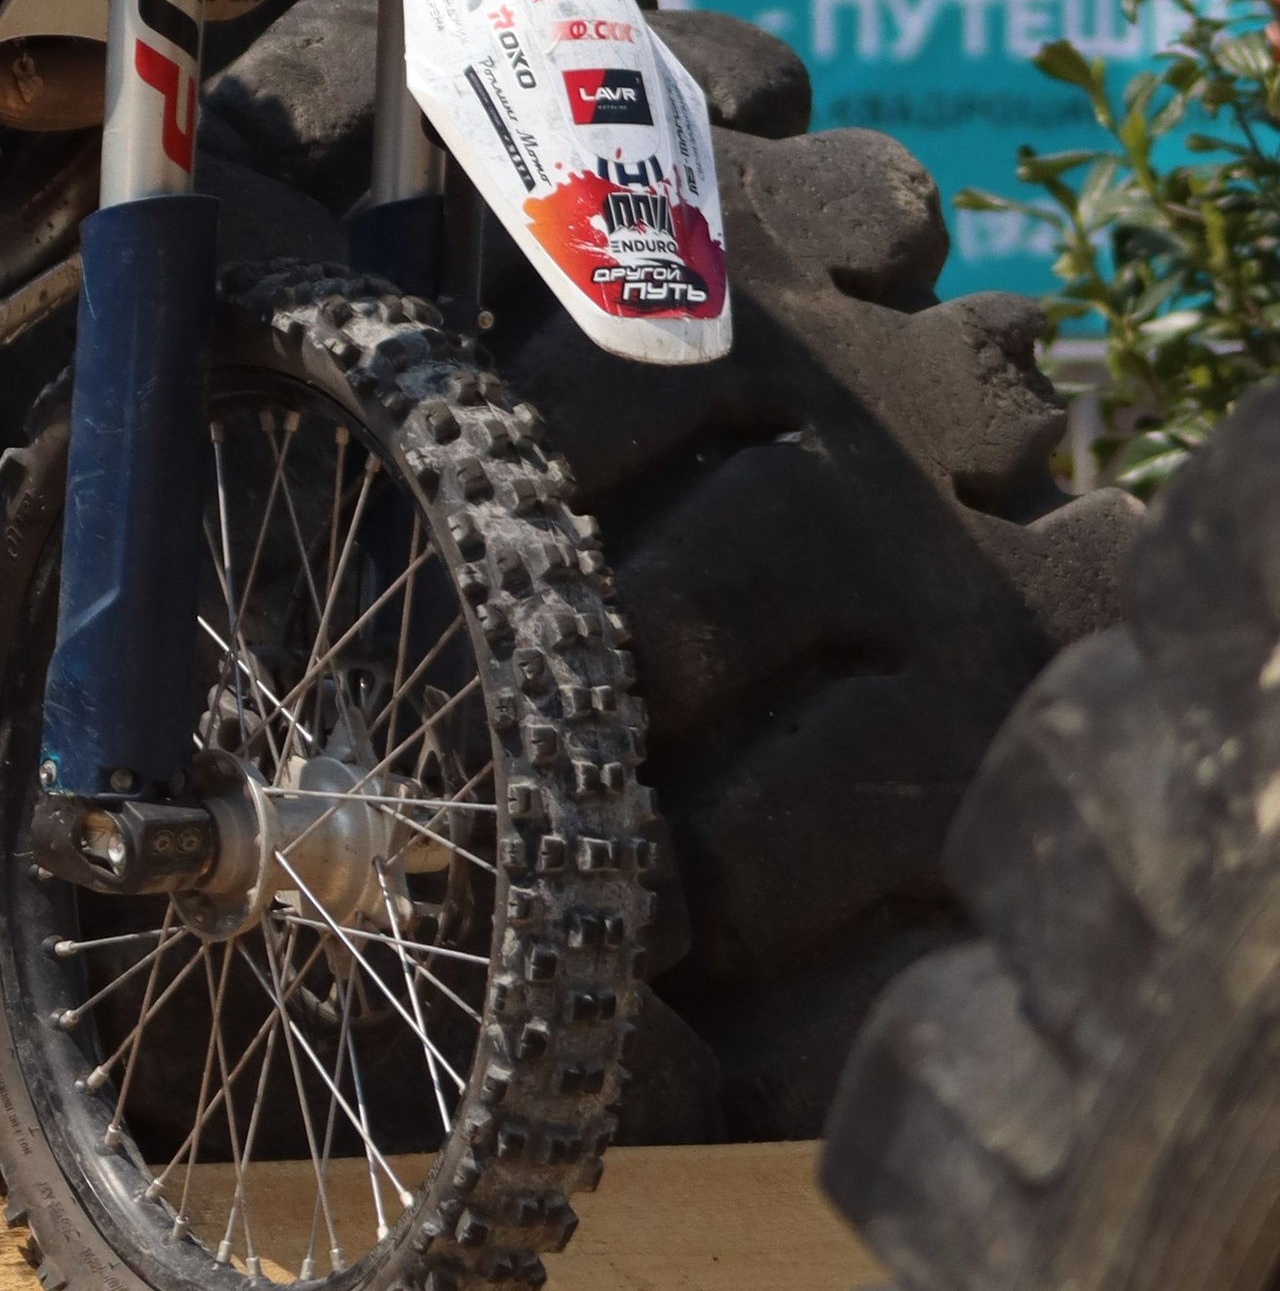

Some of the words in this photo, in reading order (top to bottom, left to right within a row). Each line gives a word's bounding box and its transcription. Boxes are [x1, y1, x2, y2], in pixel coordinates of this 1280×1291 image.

[487, 3, 538, 90] ROXO
[578, 86, 638, 103] LAVR
[516, 128, 553, 188] Мото
[610, 239, 679, 256] ENDURO
[592, 263, 683, 283] ДРУГОЙ
[621, 282, 708, 303] ПУТЬ
